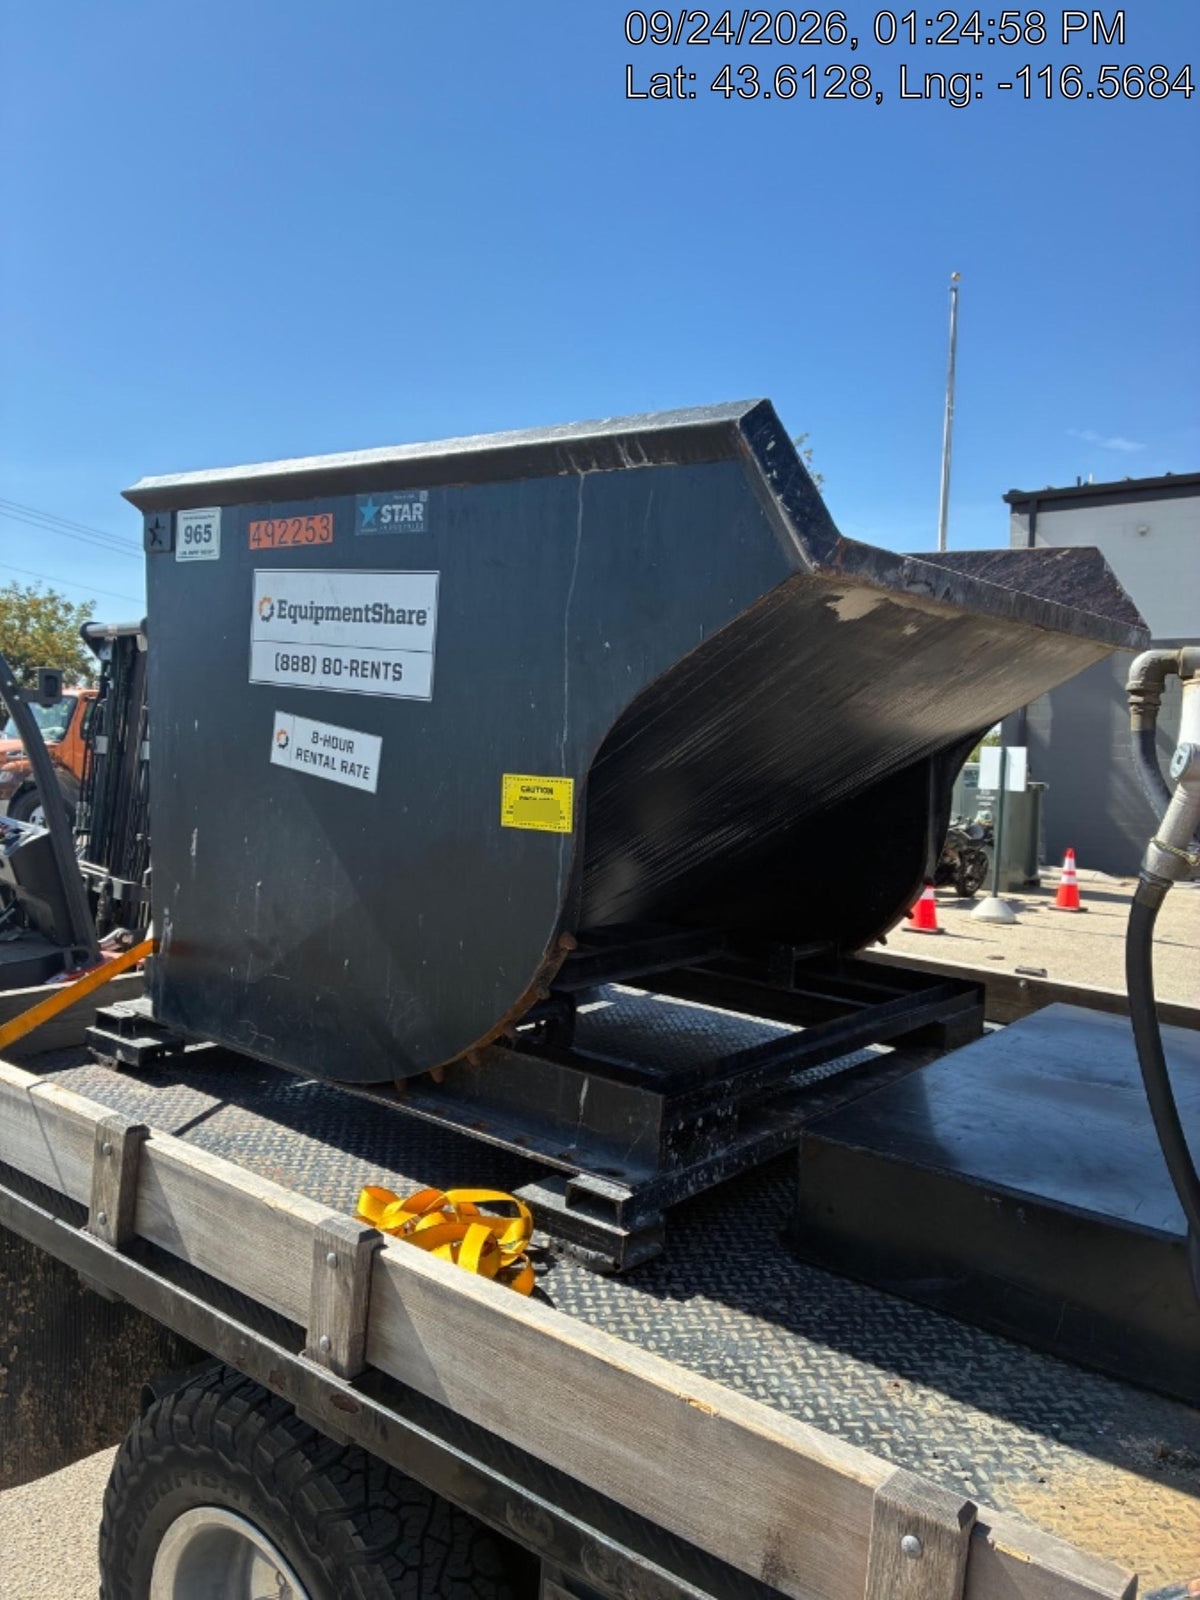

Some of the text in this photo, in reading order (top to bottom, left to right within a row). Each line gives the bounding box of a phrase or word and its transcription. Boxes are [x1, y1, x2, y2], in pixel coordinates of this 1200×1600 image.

[381, 503, 424, 523] STAR
[184, 524, 212, 544] 965
[252, 515, 330, 546] 492253
[277, 599, 427, 626] EquipmentShare
[274, 652, 403, 682] (888) 80-RENTS
[312, 731, 354, 754] 8-HOUR
[295, 747, 370, 780] RENTAL RATE
[520, 785, 554, 795] CAUTION
